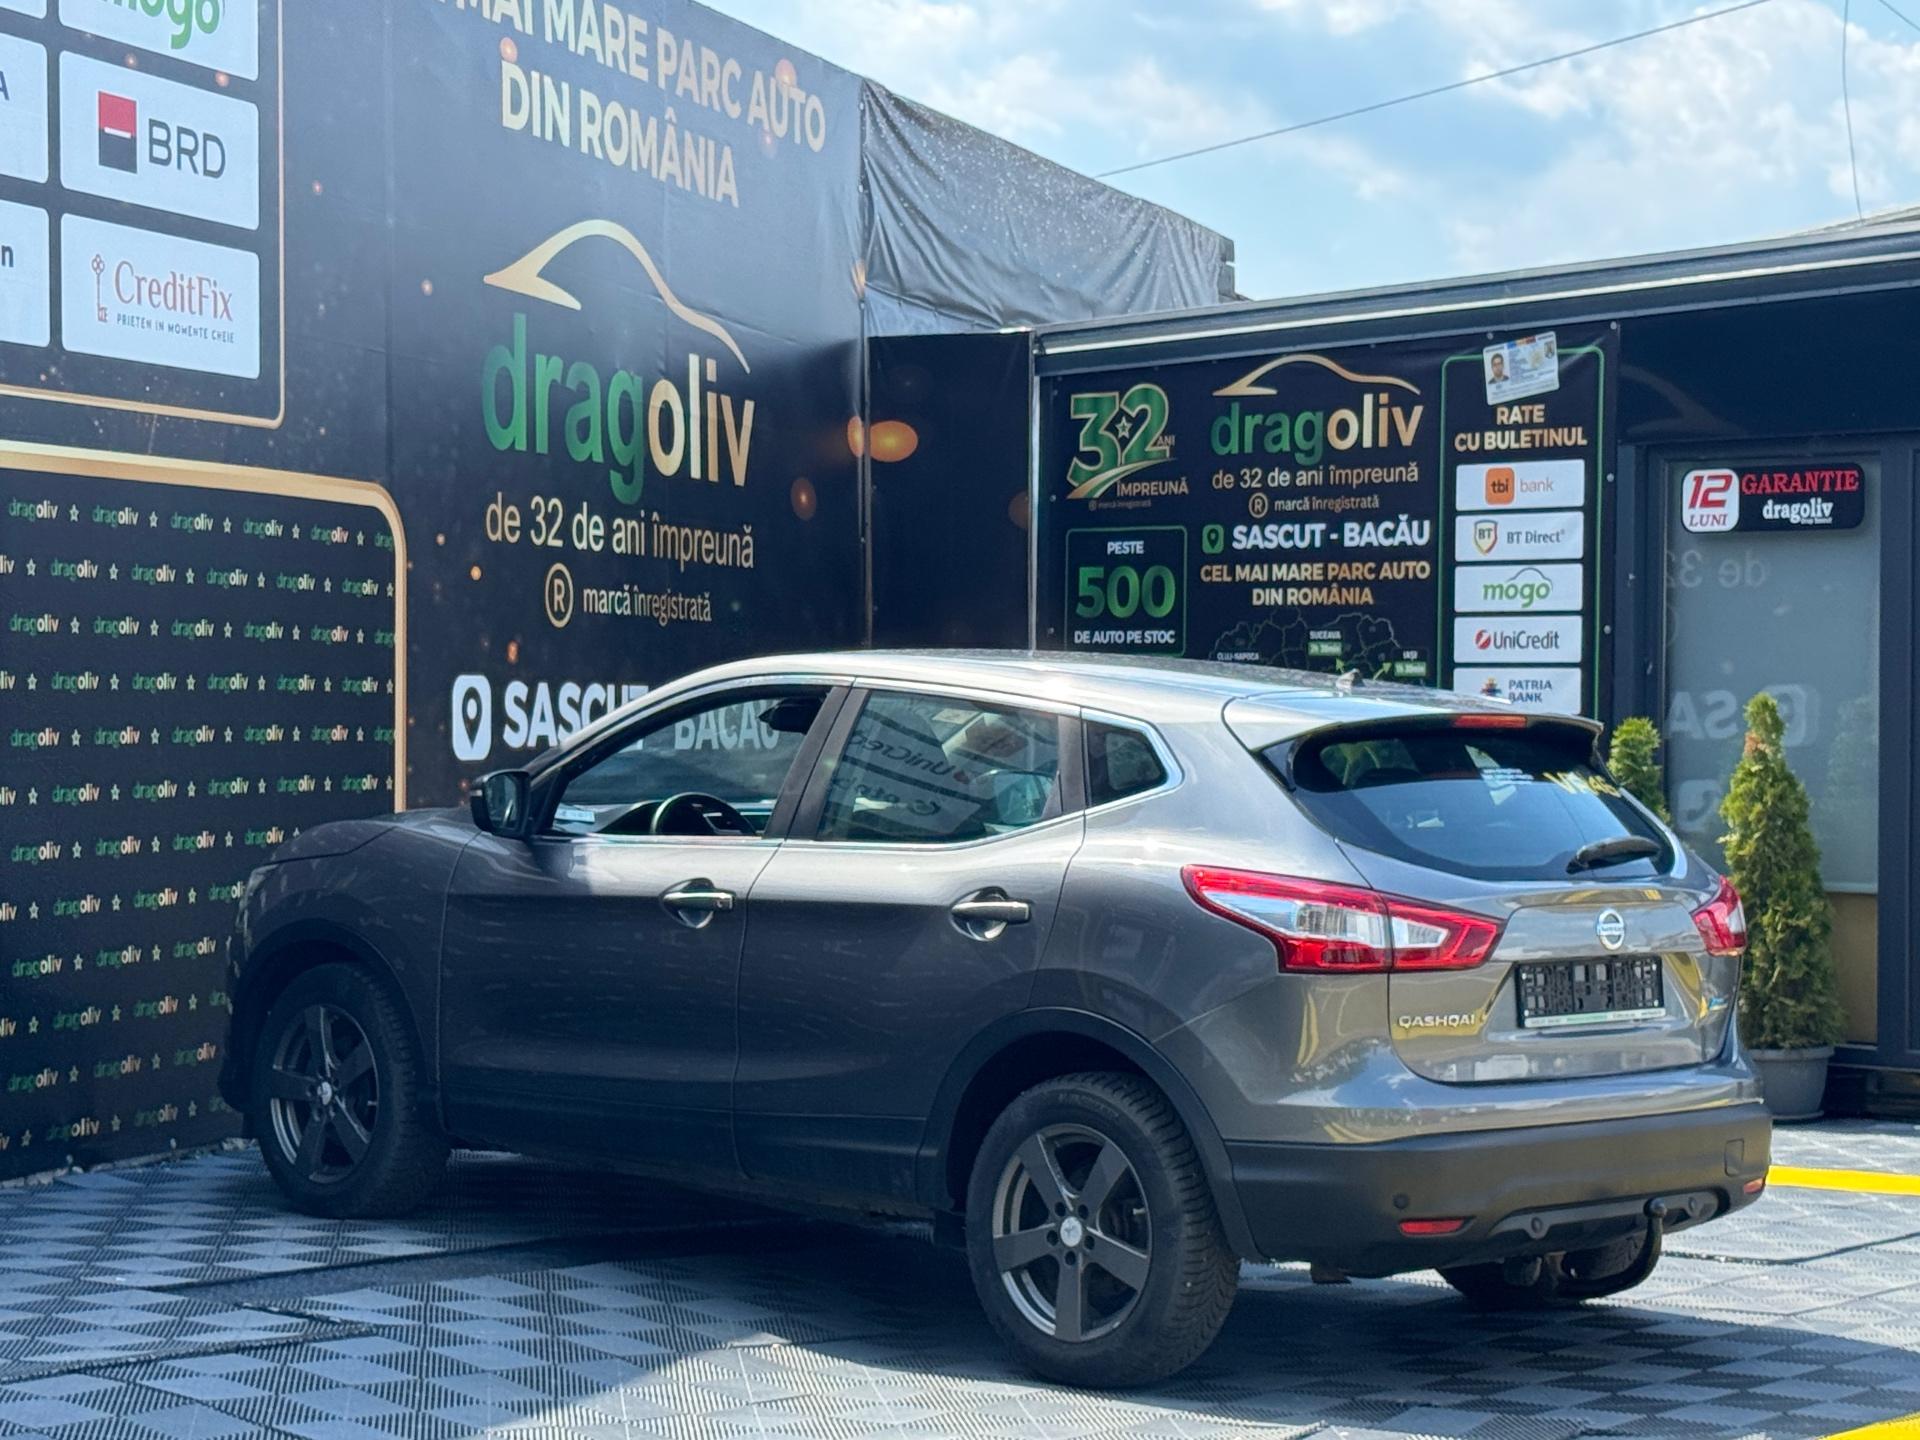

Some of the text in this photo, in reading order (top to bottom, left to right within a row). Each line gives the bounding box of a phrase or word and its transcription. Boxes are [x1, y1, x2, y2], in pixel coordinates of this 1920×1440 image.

[543, 0, 649, 82] MARE
[657, 27, 742, 120] PARC
[747, 70, 826, 153] AUTO
[501, 60, 740, 209] DIN ROMÂNIA
[148, 118, 227, 180] BRD
[114, 259, 234, 322] CreditFix
[117, 312, 152, 330] PRIETEN
[481, 312, 756, 505] dragoliv
[1496, 405, 1545, 425] RATE
[1066, 383, 1170, 489] 32
[1210, 393, 1424, 466] dragoliv
[1454, 427, 1588, 452] CU BULETINUL
[1116, 477, 1189, 497] ÎMPREUNĂ
[1212, 461, 1419, 490] de 32 de ani împreună
[1490, 477, 1554, 493] tbi bank
[1741, 470, 1860, 495] GARANTIE
[1274, 495, 1310, 512] marcă
[1311, 494, 1380, 514] înregistrată
[1688, 474, 1733, 509] 12
[8, 497, 59, 522] dragoliv
[91, 504, 139, 528] dragoliv
[170, 511, 214, 533] dragoliv
[242, 517, 284, 540] dragoliv
[310, 524, 350, 546] dragoliv
[1688, 514, 1728, 527] LUNI
[1762, 498, 1834, 524] dragoliv
[485, 491, 754, 573] de 32 de ani împreună
[1231, 522, 1327, 550] SASCUT
[1343, 514, 1431, 548] BACĂU
[1478, 528, 1493, 540] BT
[1506, 532, 1523, 544] BT
[1106, 540, 1145, 555] PESTE
[51, 557, 99, 581] dragoliv
[131, 563, 177, 585] dragoliv
[206, 568, 248, 589] dragoliv
[276, 572, 316, 594] dragoliv
[341, 578, 379, 598] dragoliv
[1200, 561, 1431, 582] CEL MAI MARE PARC AUTO
[1074, 565, 1176, 619] 500
[1252, 583, 1374, 606] DIN ROMÂNIA
[1483, 582, 1551, 608] mogo
[582, 585, 632, 615] marcă
[633, 585, 712, 627] înregistrată
[9, 613, 60, 636] dragoliv
[93, 615, 140, 638] dragoliv
[170, 618, 215, 641] dragoliv
[243, 621, 284, 643] dragoliv
[310, 624, 350, 646] dragoliv
[1073, 629, 1176, 645] DE AUTO PE STOC
[1493, 630, 1560, 650] UniCredit
[51, 671, 100, 694] dragoliv
[131, 672, 177, 694] dragoliv
[207, 672, 249, 695] dragoliv
[276, 674, 317, 696] dragoliv
[341, 676, 379, 697] dragoliv
[1508, 679, 1553, 690] PATRIA
[1508, 692, 1543, 703] BANK
[10, 727, 60, 750] dragoliv
[94, 725, 141, 749] dragoliv
[171, 724, 215, 747] dragoliv
[243, 724, 285, 746] dragoliv
[310, 724, 350, 745] dragoliv
[52, 783, 101, 806] dragoliv
[132, 779, 178, 802] dragoliv
[207, 776, 250, 799] dragoliv
[276, 774, 317, 796] dragoliv
[341, 774, 379, 794] dragoliv
[11, 826, 285, 866] dragoliv dragoliv dragoliv dragoliv
[53, 894, 101, 919] dragoliv
[133, 888, 179, 911] dragoliv
[12, 936, 217, 979] dragoliv dragoliv dragoliv
[1398, 1014, 1475, 1029] QASHQAI
